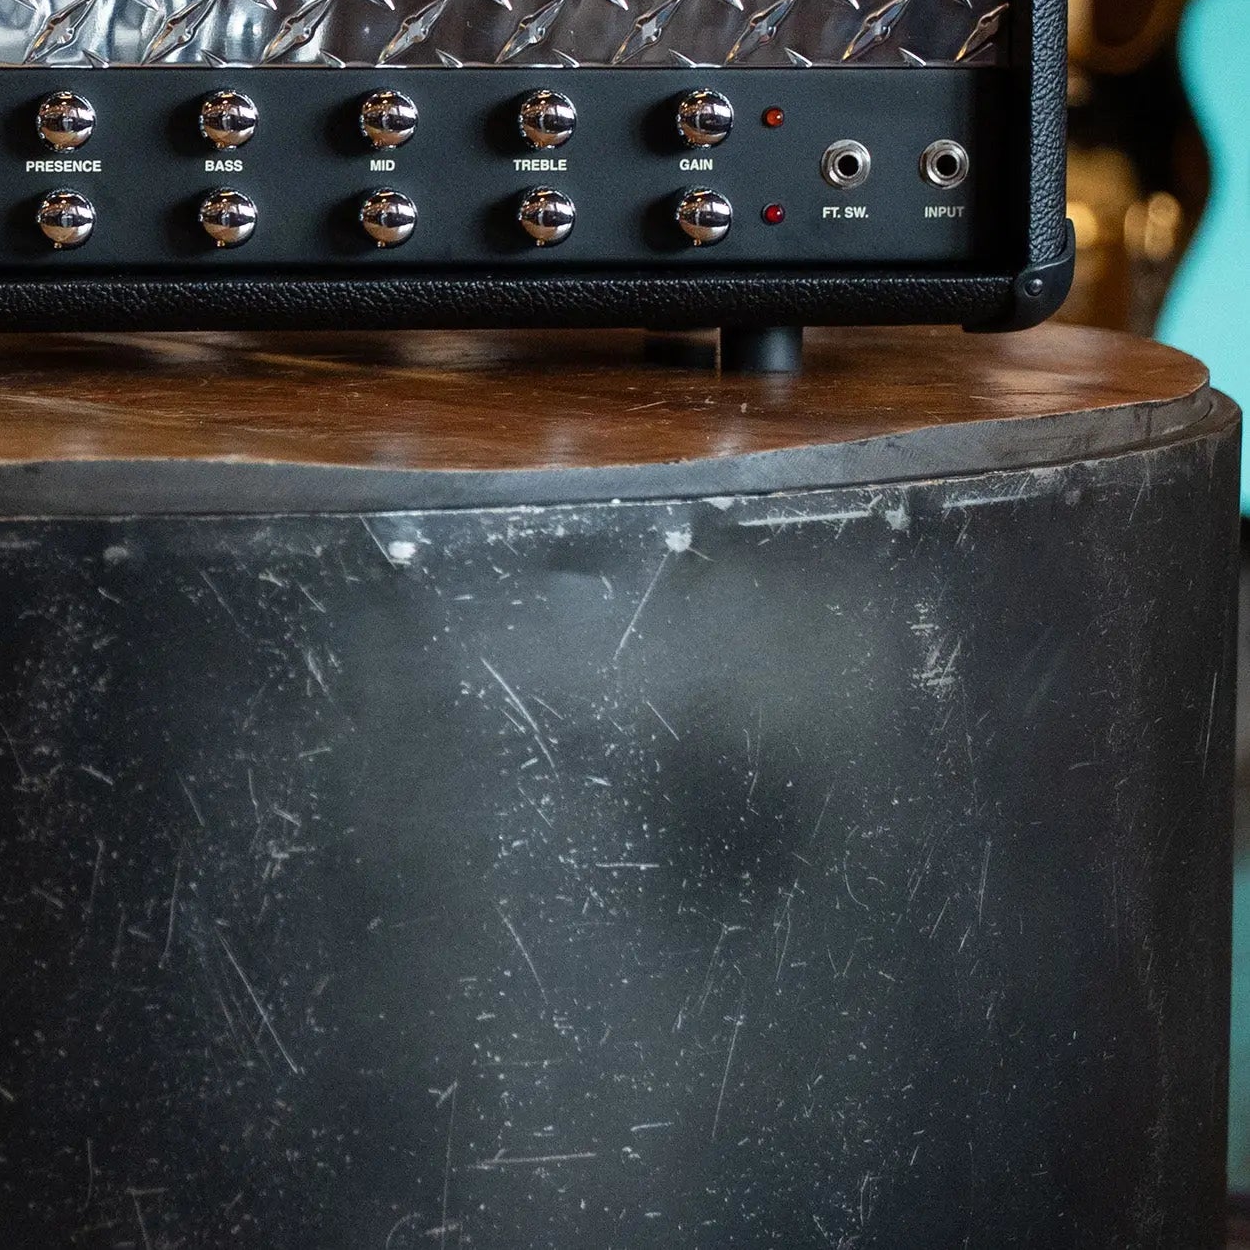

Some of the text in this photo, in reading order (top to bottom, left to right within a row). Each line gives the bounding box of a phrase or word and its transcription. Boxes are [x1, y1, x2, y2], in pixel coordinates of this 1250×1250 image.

[25, 159, 102, 173] PRESENCE
[204, 159, 244, 173] BASS
[369, 159, 396, 172] MID
[512, 158, 568, 172] TREBLE
[679, 158, 714, 171] GAIN
[822, 205, 870, 219] FT. SW.
[924, 205, 964, 218] INPUT
